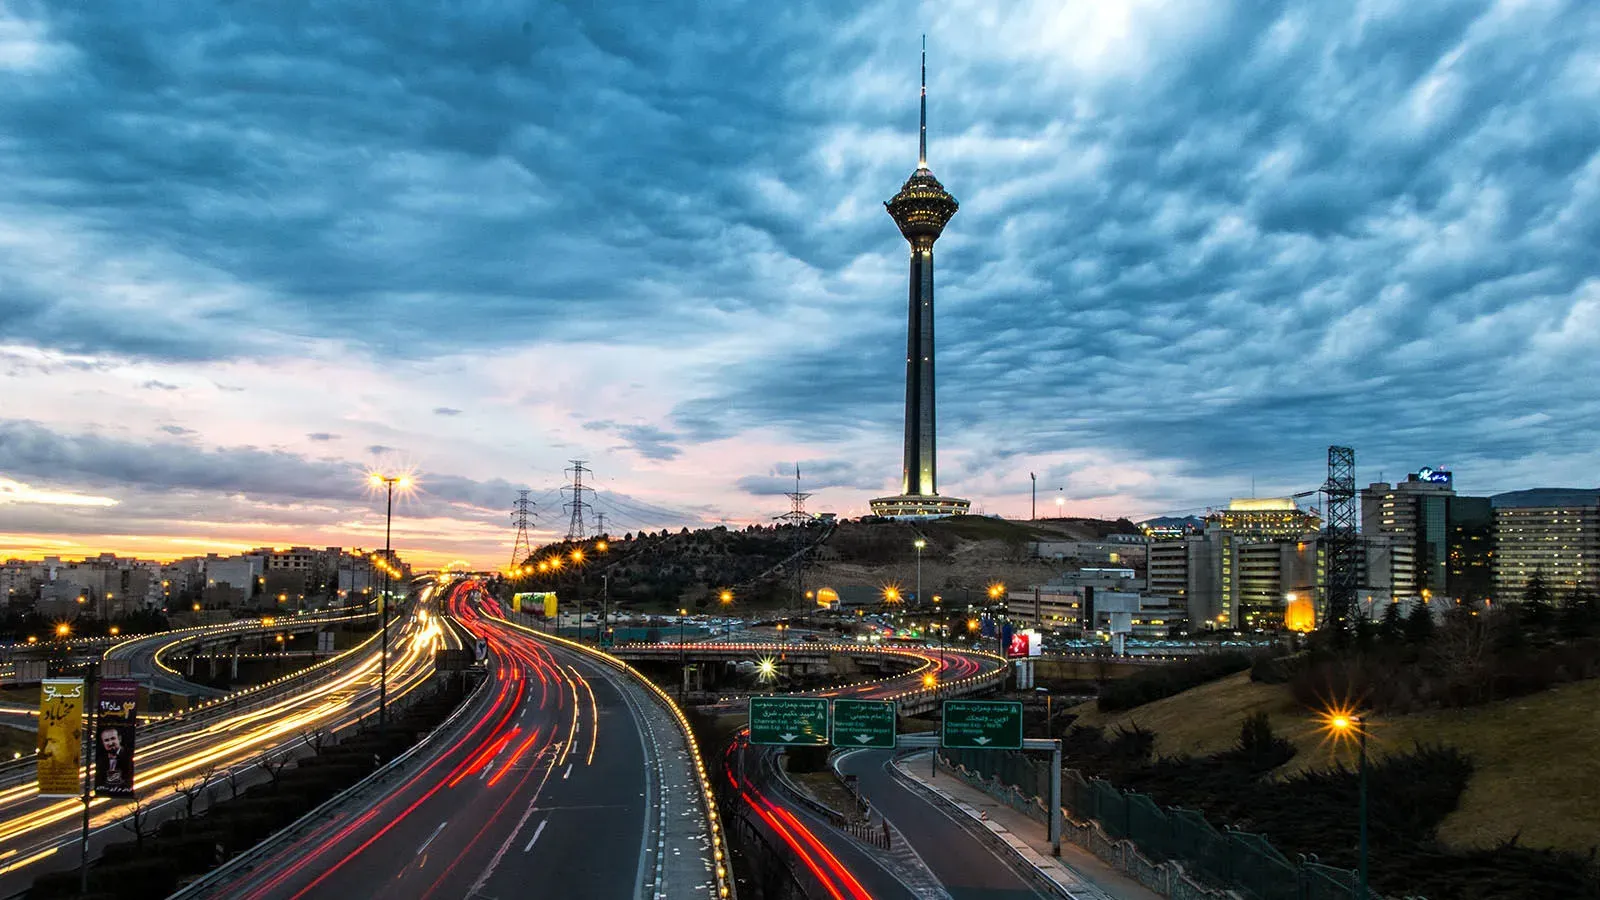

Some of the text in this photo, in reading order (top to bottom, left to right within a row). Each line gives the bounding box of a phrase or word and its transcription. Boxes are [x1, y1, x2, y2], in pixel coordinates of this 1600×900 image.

[43, 685, 82, 701] کنسرت
[779, 701, 798, 710] چمران
[799, 701, 816, 709] شهید
[782, 711, 798, 719] حکیم
